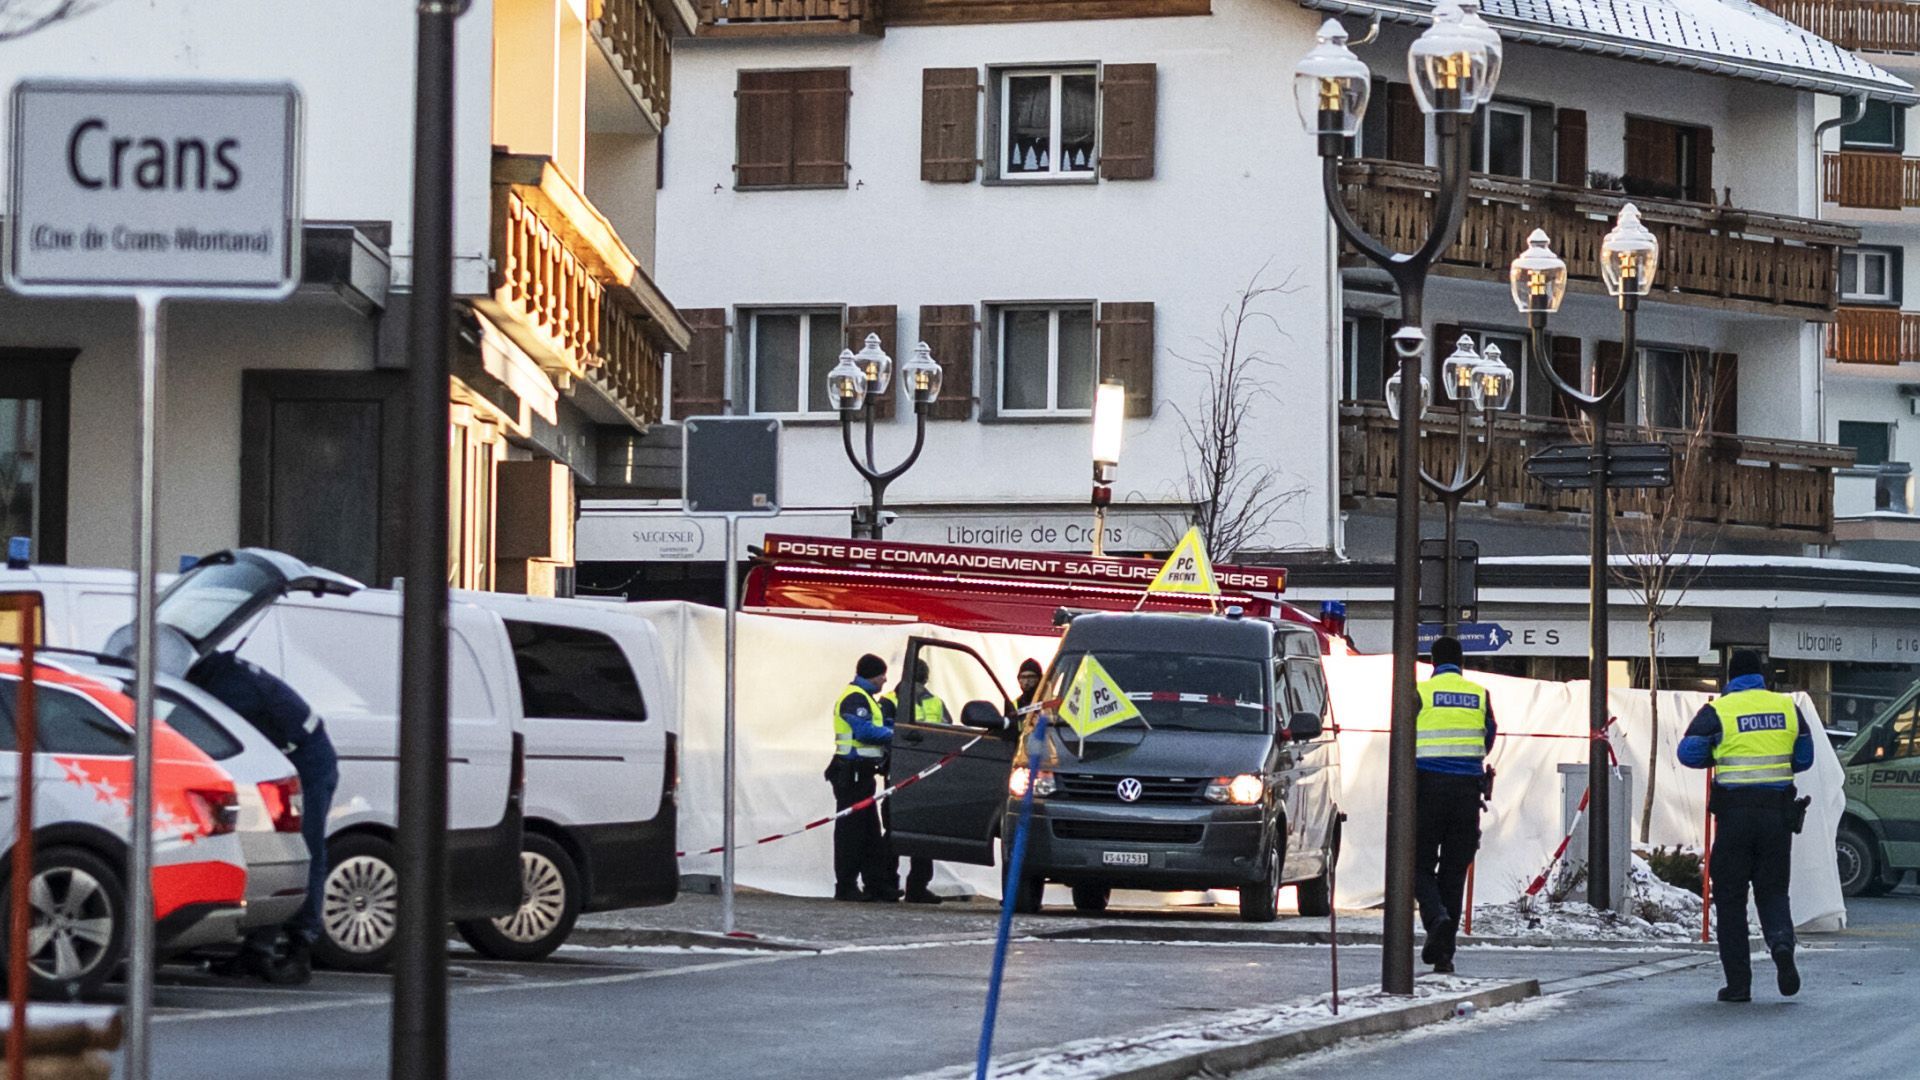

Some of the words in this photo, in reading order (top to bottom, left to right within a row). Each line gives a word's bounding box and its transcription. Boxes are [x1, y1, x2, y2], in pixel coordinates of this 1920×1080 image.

[67, 118, 242, 190] Crans
[632, 531, 694, 543] SAEGESSER
[948, 525, 1023, 544] Librairie
[1031, 525, 1057, 543] de
[778, 541, 846, 558] POSTE
[849, 547, 877, 560] DE
[881, 549, 1061, 573] COMMANDEMENT
[1213, 572, 1268, 588] PIERS
[1176, 557, 1194, 571] PC
[1168, 572, 1196, 582] FRONT
[1797, 632, 1843, 653] Librairie
[1094, 687, 1109, 704] PC
[1435, 693, 1478, 707] POLICE
[1093, 701, 1118, 718] FRONT
[1741, 715, 1784, 731] POLICE
